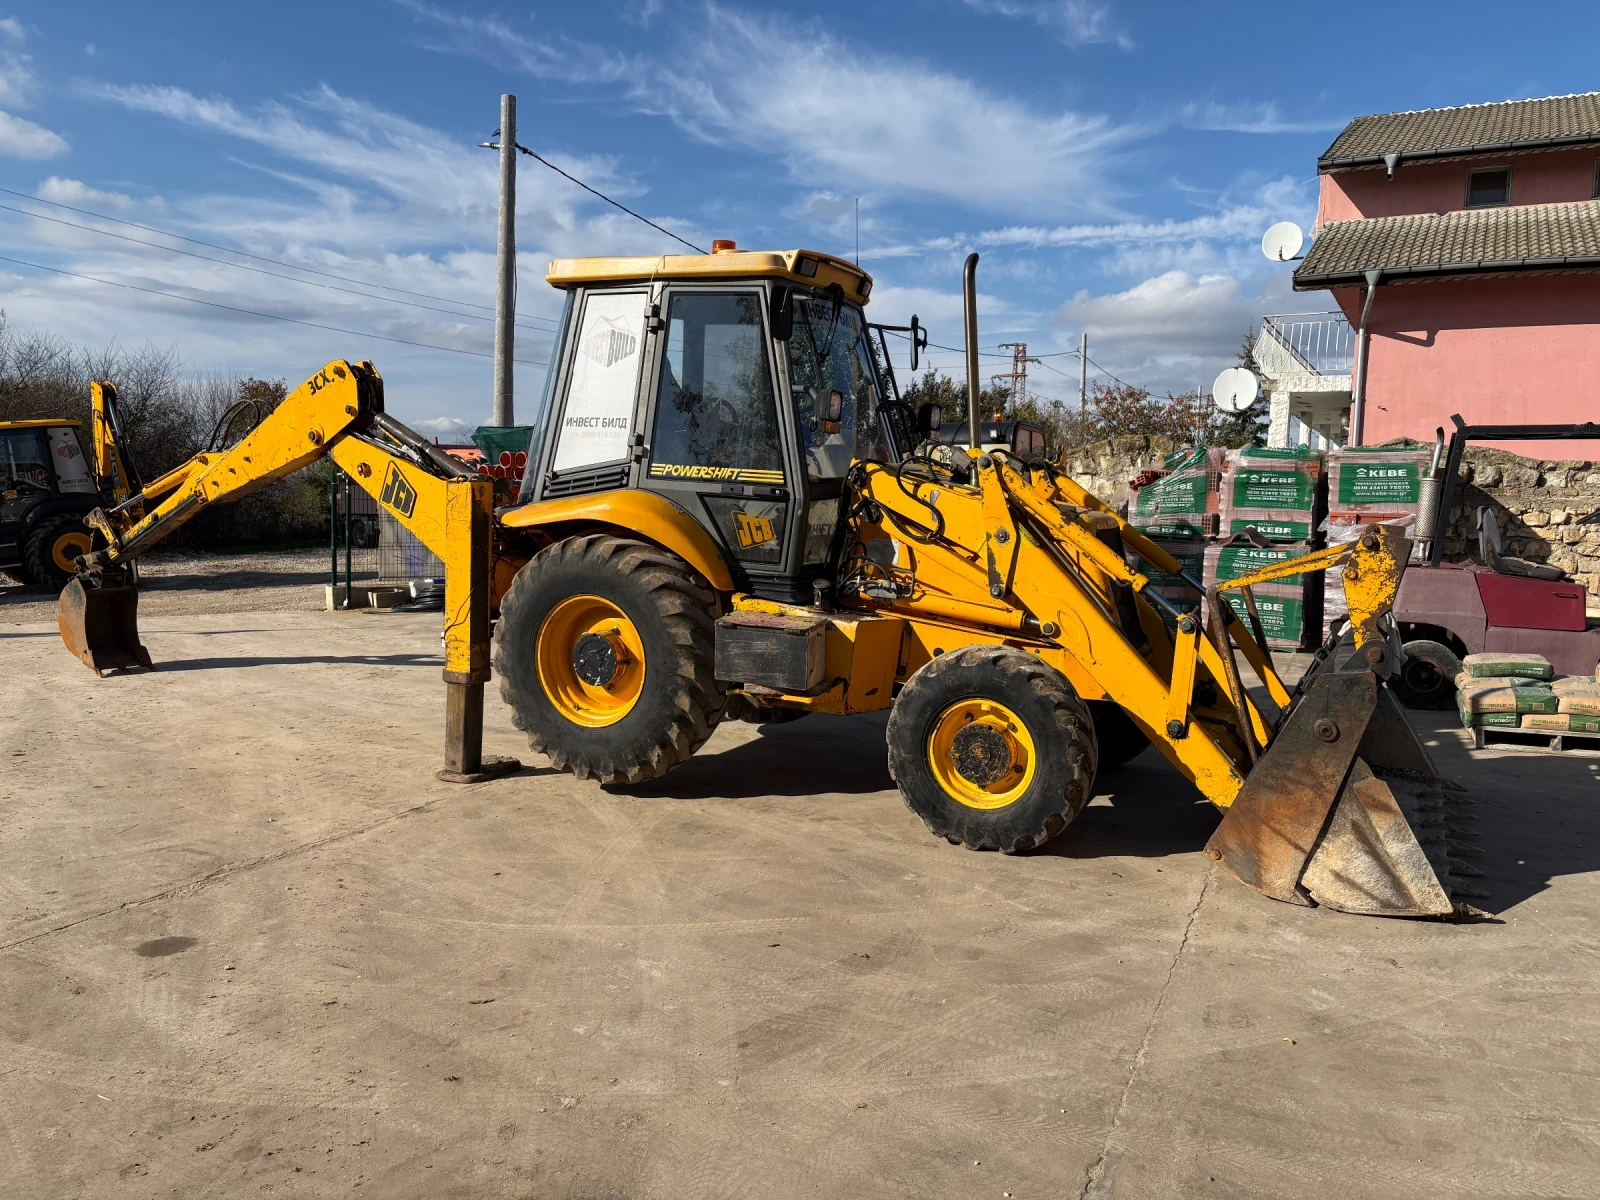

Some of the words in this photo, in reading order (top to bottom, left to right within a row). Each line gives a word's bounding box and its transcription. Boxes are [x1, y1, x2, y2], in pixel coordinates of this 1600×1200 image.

[607, 329, 636, 368] BUILD
[566, 416, 600, 428] ИНВЕСТ
[602, 417, 628, 430] БИЛД
[662, 464, 741, 480] POWERSHIFT
[1369, 469, 1407, 477] KEBE
[381, 466, 414, 514] JCB
[737, 513, 774, 547] JCB
[1249, 551, 1288, 559] KEBE
